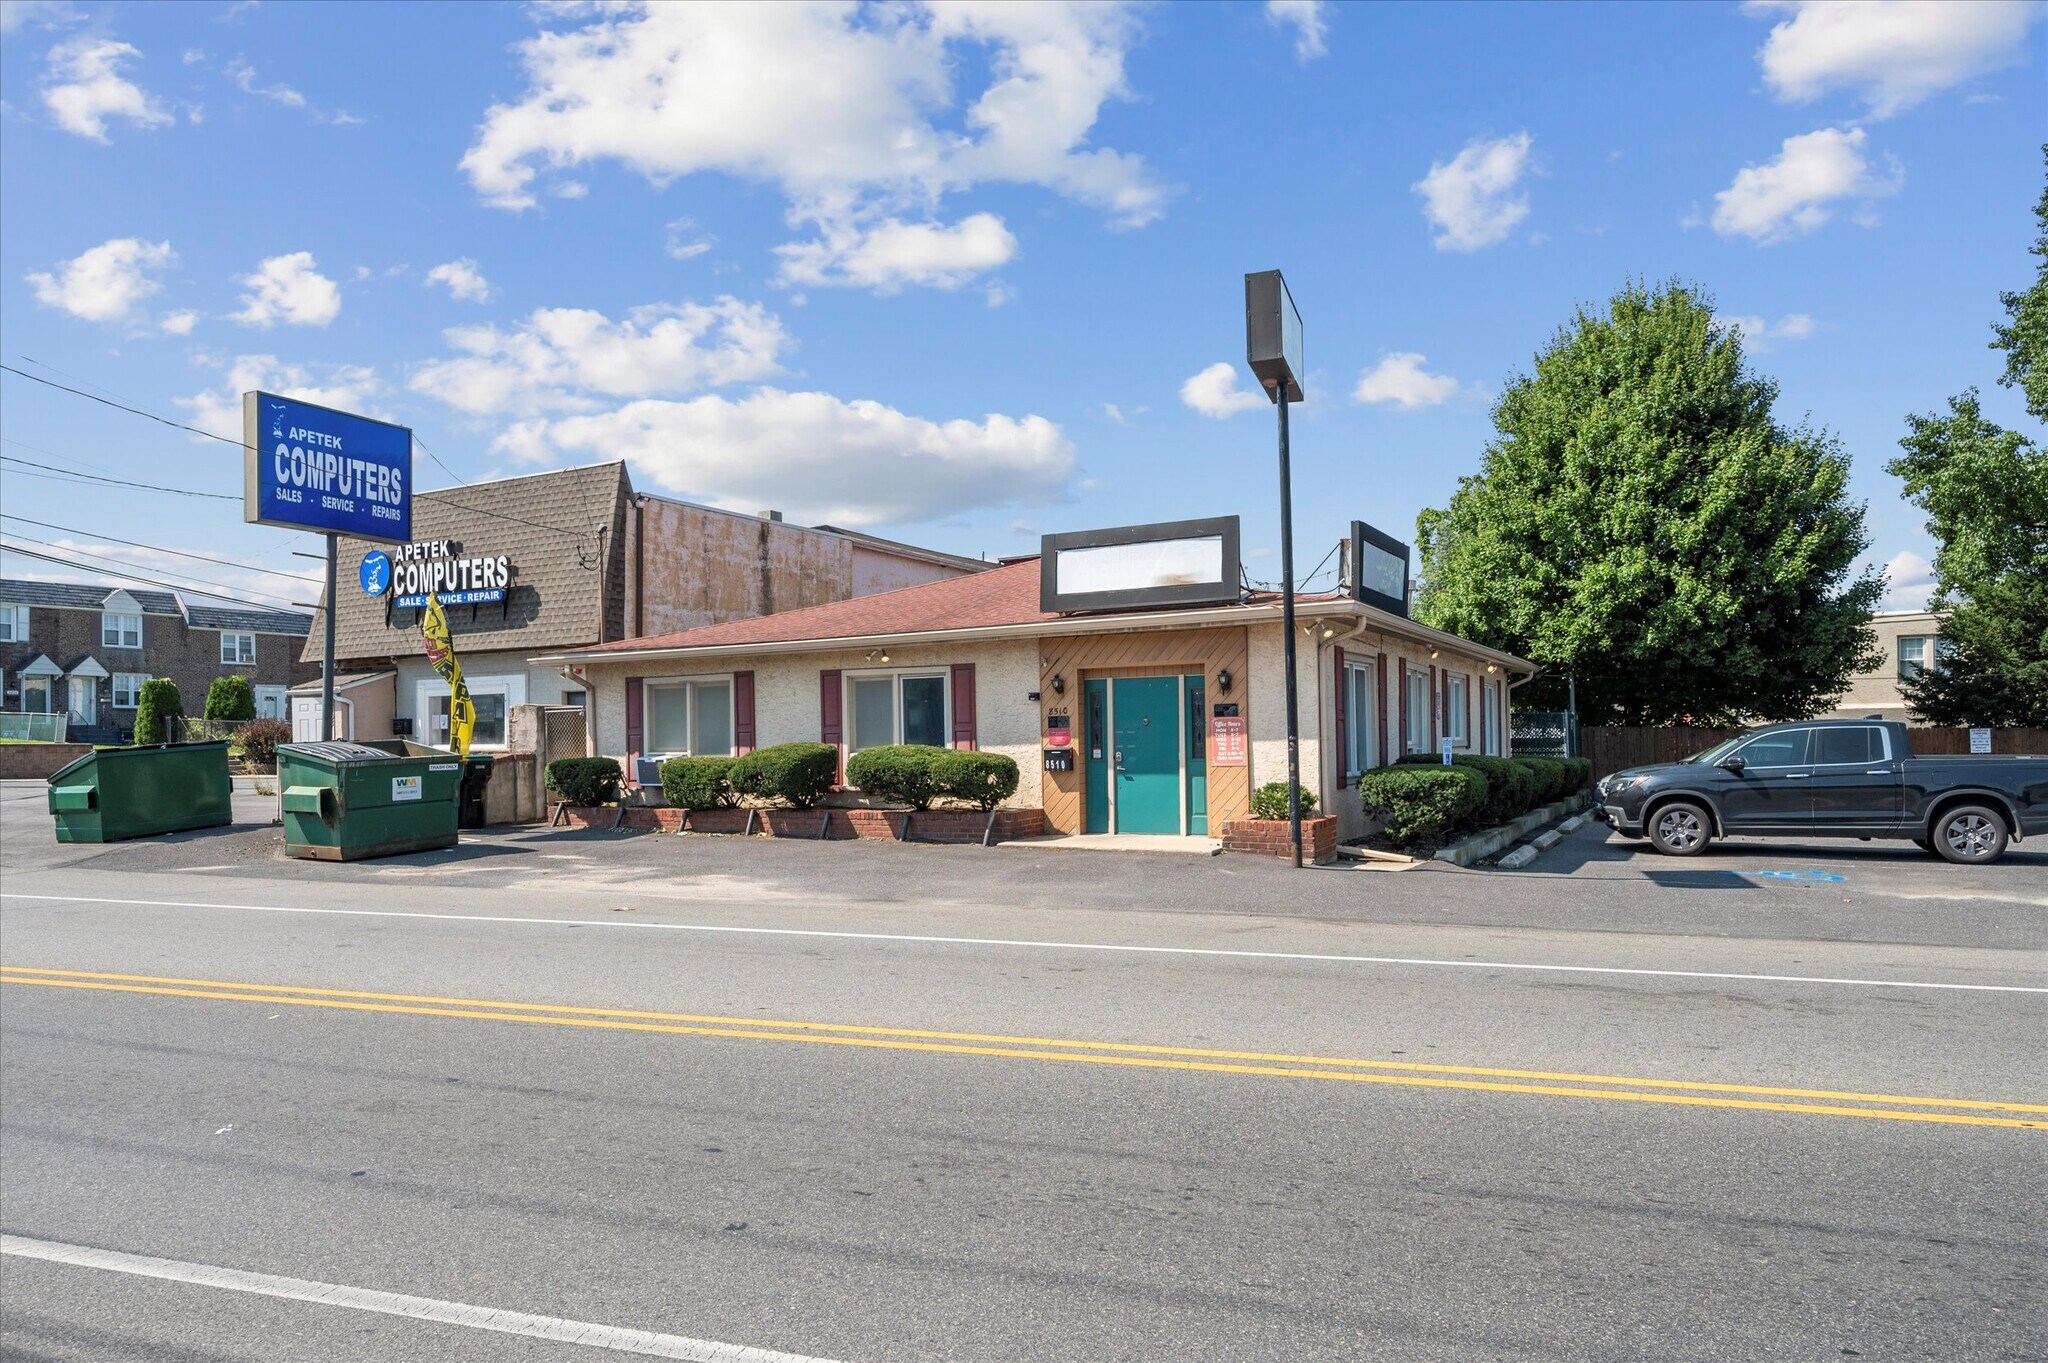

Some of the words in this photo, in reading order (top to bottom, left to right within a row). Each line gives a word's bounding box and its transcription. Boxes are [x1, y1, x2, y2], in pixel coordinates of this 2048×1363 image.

[288, 426, 343, 450] APETEK
[275, 443, 402, 505] COMPUTERS
[276, 487, 303, 504] SALES
[321, 495, 354, 513] SERVICE
[371, 504, 401, 521] REPAIRS
[395, 540, 450, 562] APETEK
[393, 555, 509, 595] COMPUTERS
[399, 596, 422, 607] SALE
[425, 594, 462, 605] SRVICE
[467, 590, 500, 601] REPAIR
[1048, 706, 1068, 715] 8510
[1045, 759, 1066, 769] 8510
[396, 778, 417, 786] WM
